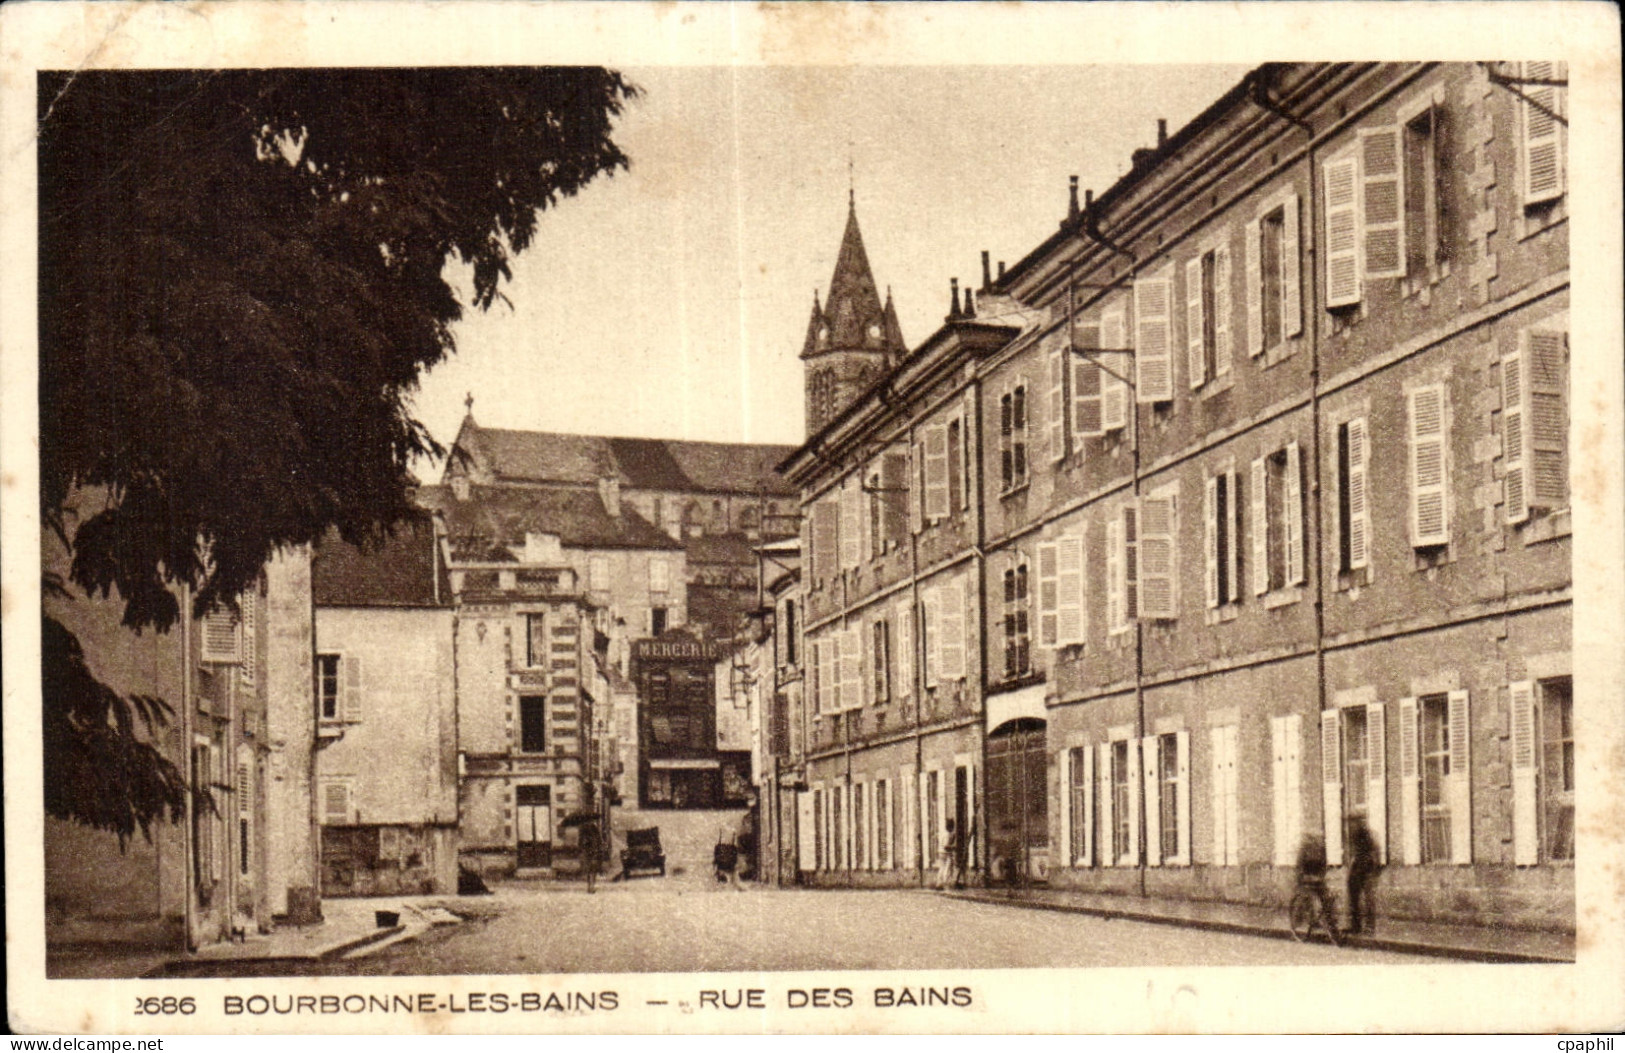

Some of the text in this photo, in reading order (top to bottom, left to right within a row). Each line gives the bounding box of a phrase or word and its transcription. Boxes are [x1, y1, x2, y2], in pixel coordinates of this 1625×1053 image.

[639, 642, 717, 657] MERCERIE
[224, 991, 619, 1014] BOURBONNE-LES-BAINS
[700, 989, 765, 1009] RUE
[787, 988, 853, 1008] DES
[874, 987, 972, 1007] BAINS
